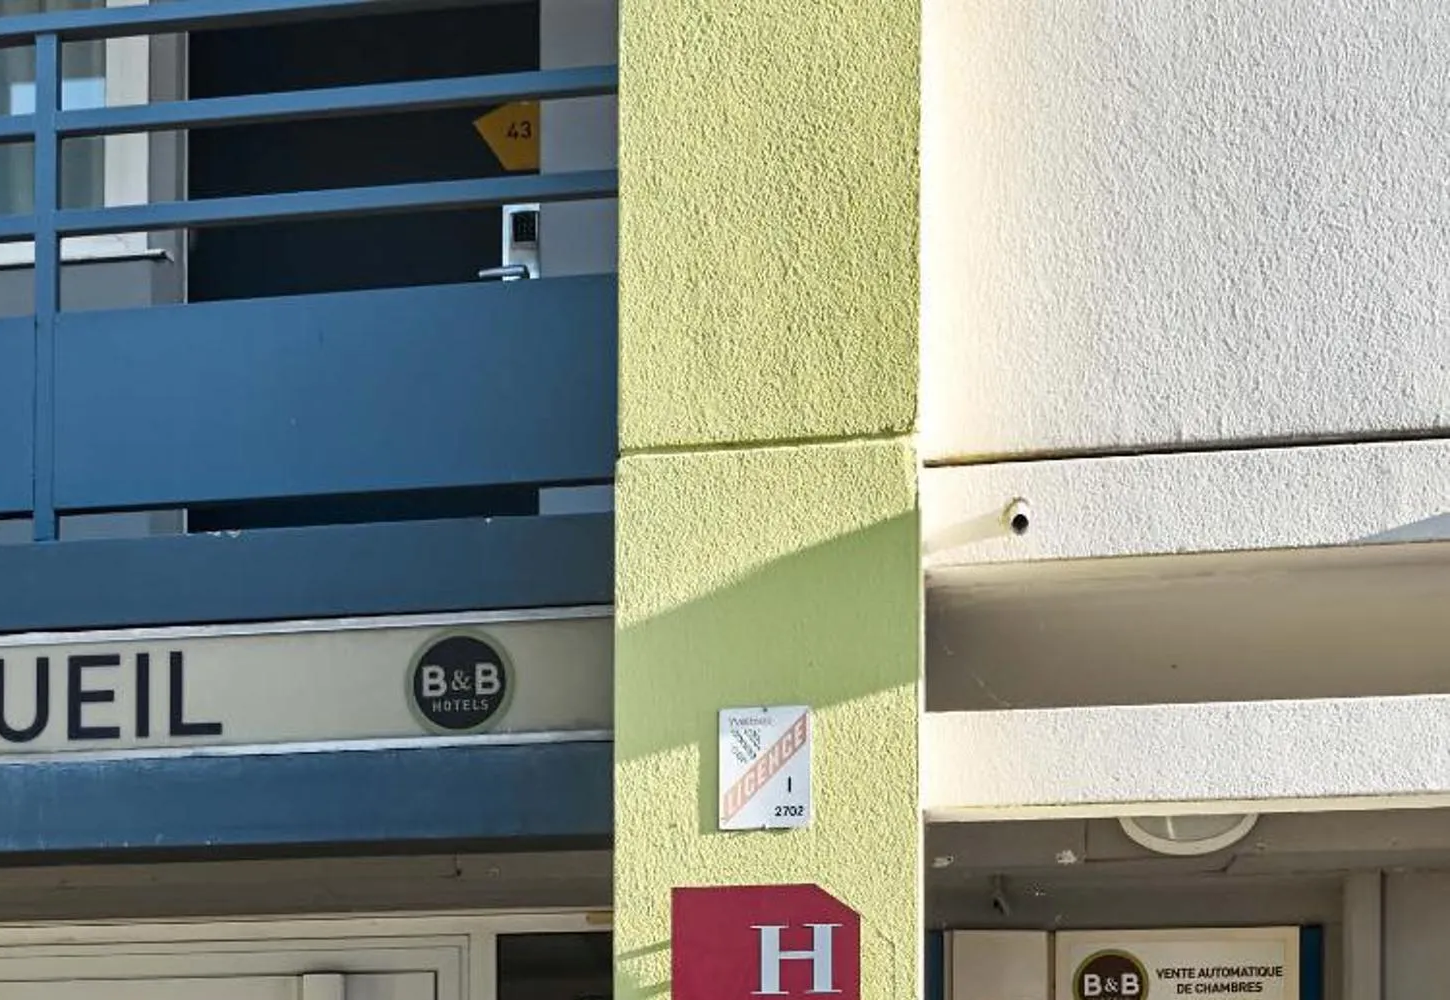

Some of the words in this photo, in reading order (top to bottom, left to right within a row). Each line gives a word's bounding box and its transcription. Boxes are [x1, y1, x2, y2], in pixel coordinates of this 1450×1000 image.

[507, 121, 531, 139] 43
[422, 662, 501, 697] B&B
[432, 698, 489, 713] HOTELS
[725, 715, 807, 816] LICENCE
[774, 805, 804, 817] 2702
[750, 923, 843, 995] H
[1155, 968, 1196, 979] VENTE
[1198, 965, 1284, 978] AUTOMATIQUE
[1084, 973, 1140, 997] B&B
[1177, 984, 1193, 995] DE
[1195, 982, 1263, 994] CHAMBRES
